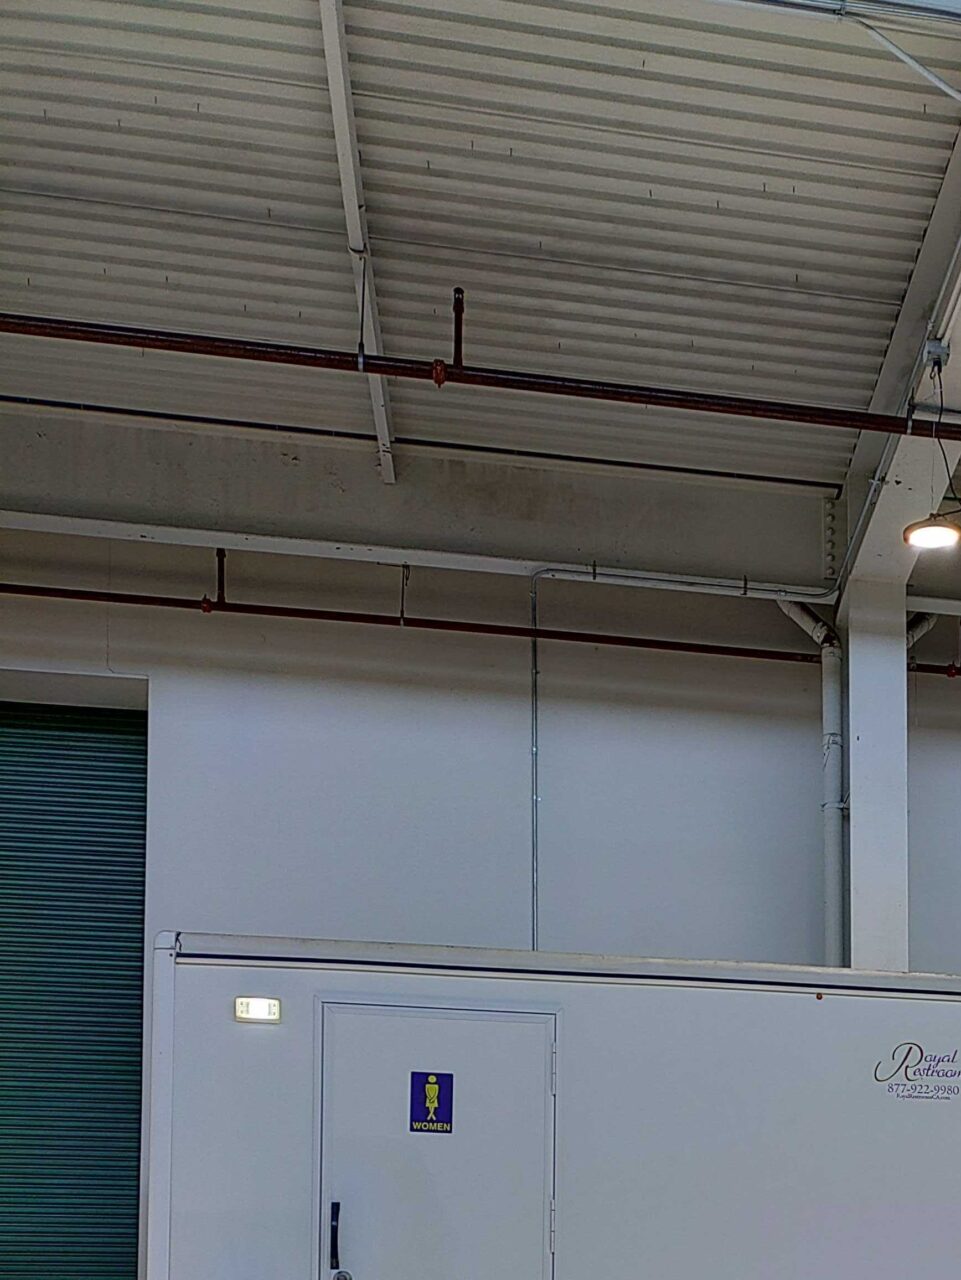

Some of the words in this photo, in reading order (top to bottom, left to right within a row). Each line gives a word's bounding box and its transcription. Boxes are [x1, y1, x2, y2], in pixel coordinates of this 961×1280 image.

[874, 1042, 958, 1082] Royal
[887, 1083, 960, 1096] 877-922-9980
[412, 1121, 451, 1131] WOMEN
